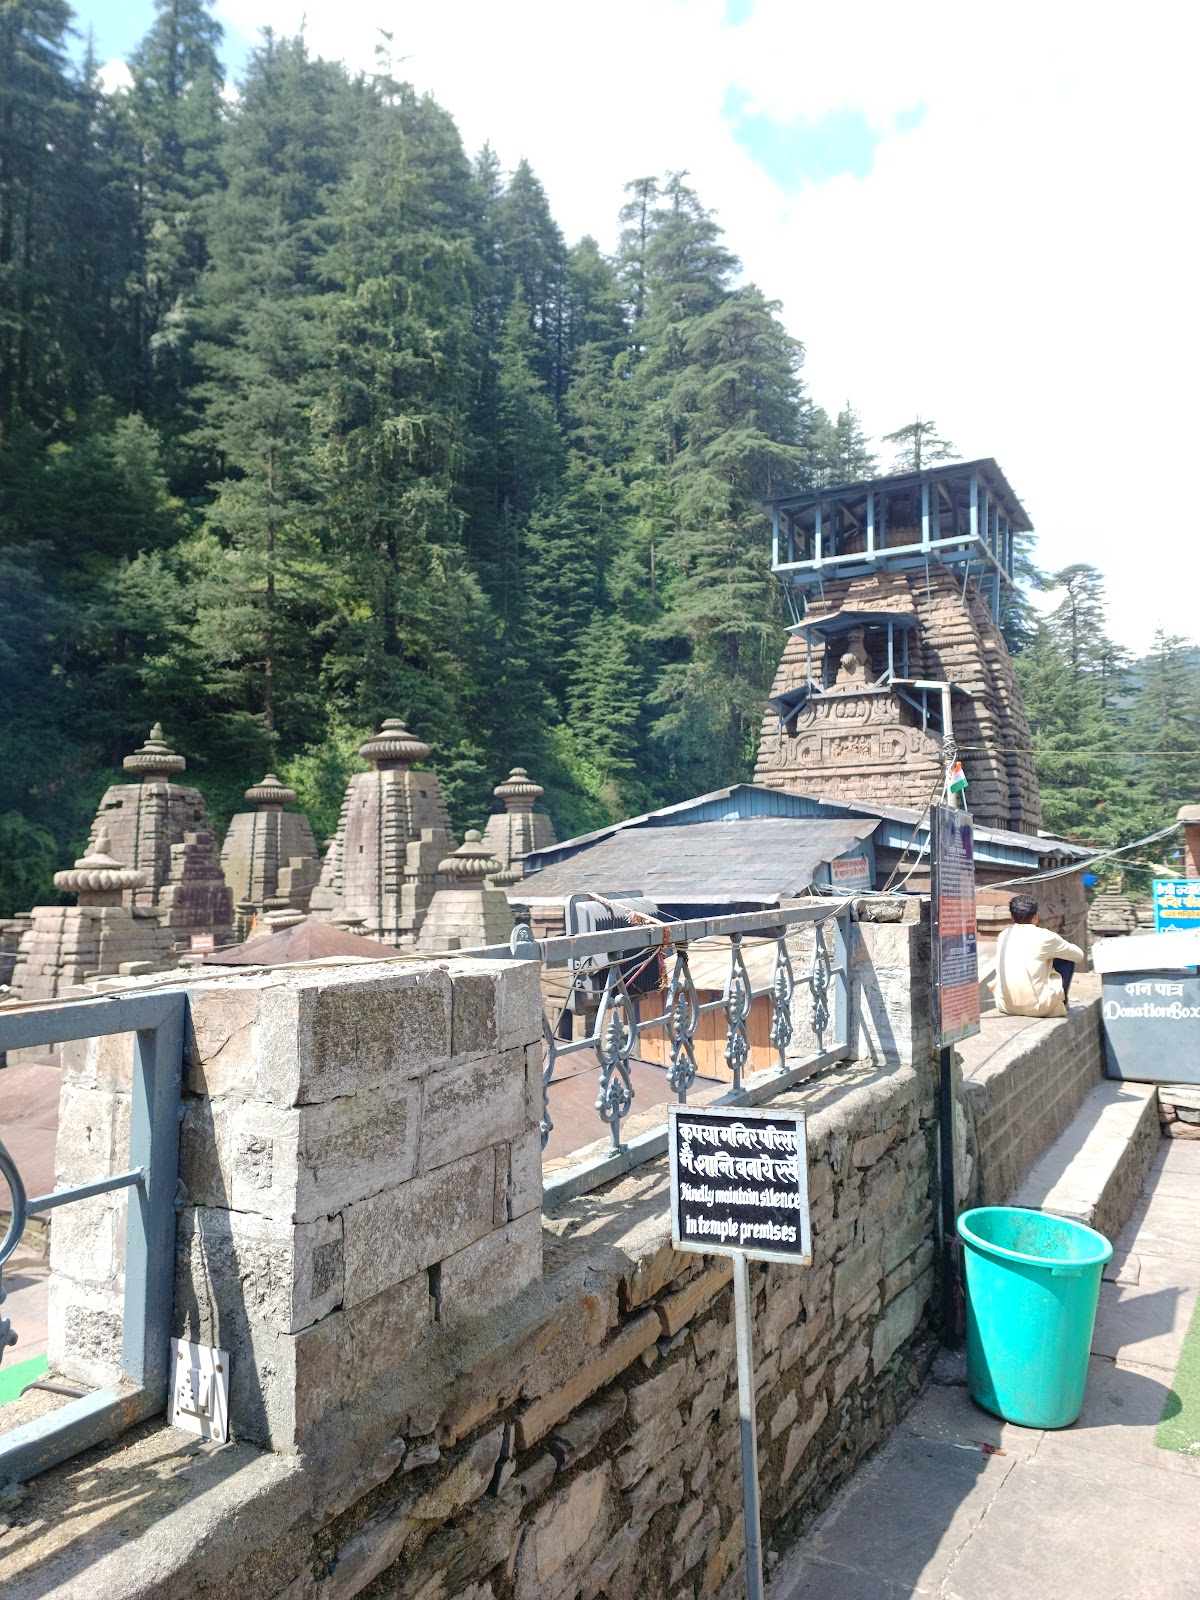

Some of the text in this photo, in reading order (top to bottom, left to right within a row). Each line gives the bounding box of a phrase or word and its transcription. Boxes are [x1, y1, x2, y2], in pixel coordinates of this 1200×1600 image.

[1125, 983, 1184, 996] दान पात्र
[720, 1122, 761, 1149] मन्दिर
[694, 1151, 738, 1179] शान्ति
[680, 1182, 800, 1209] Kindly maintain silence
[686, 1215, 797, 1244] in temple premises
